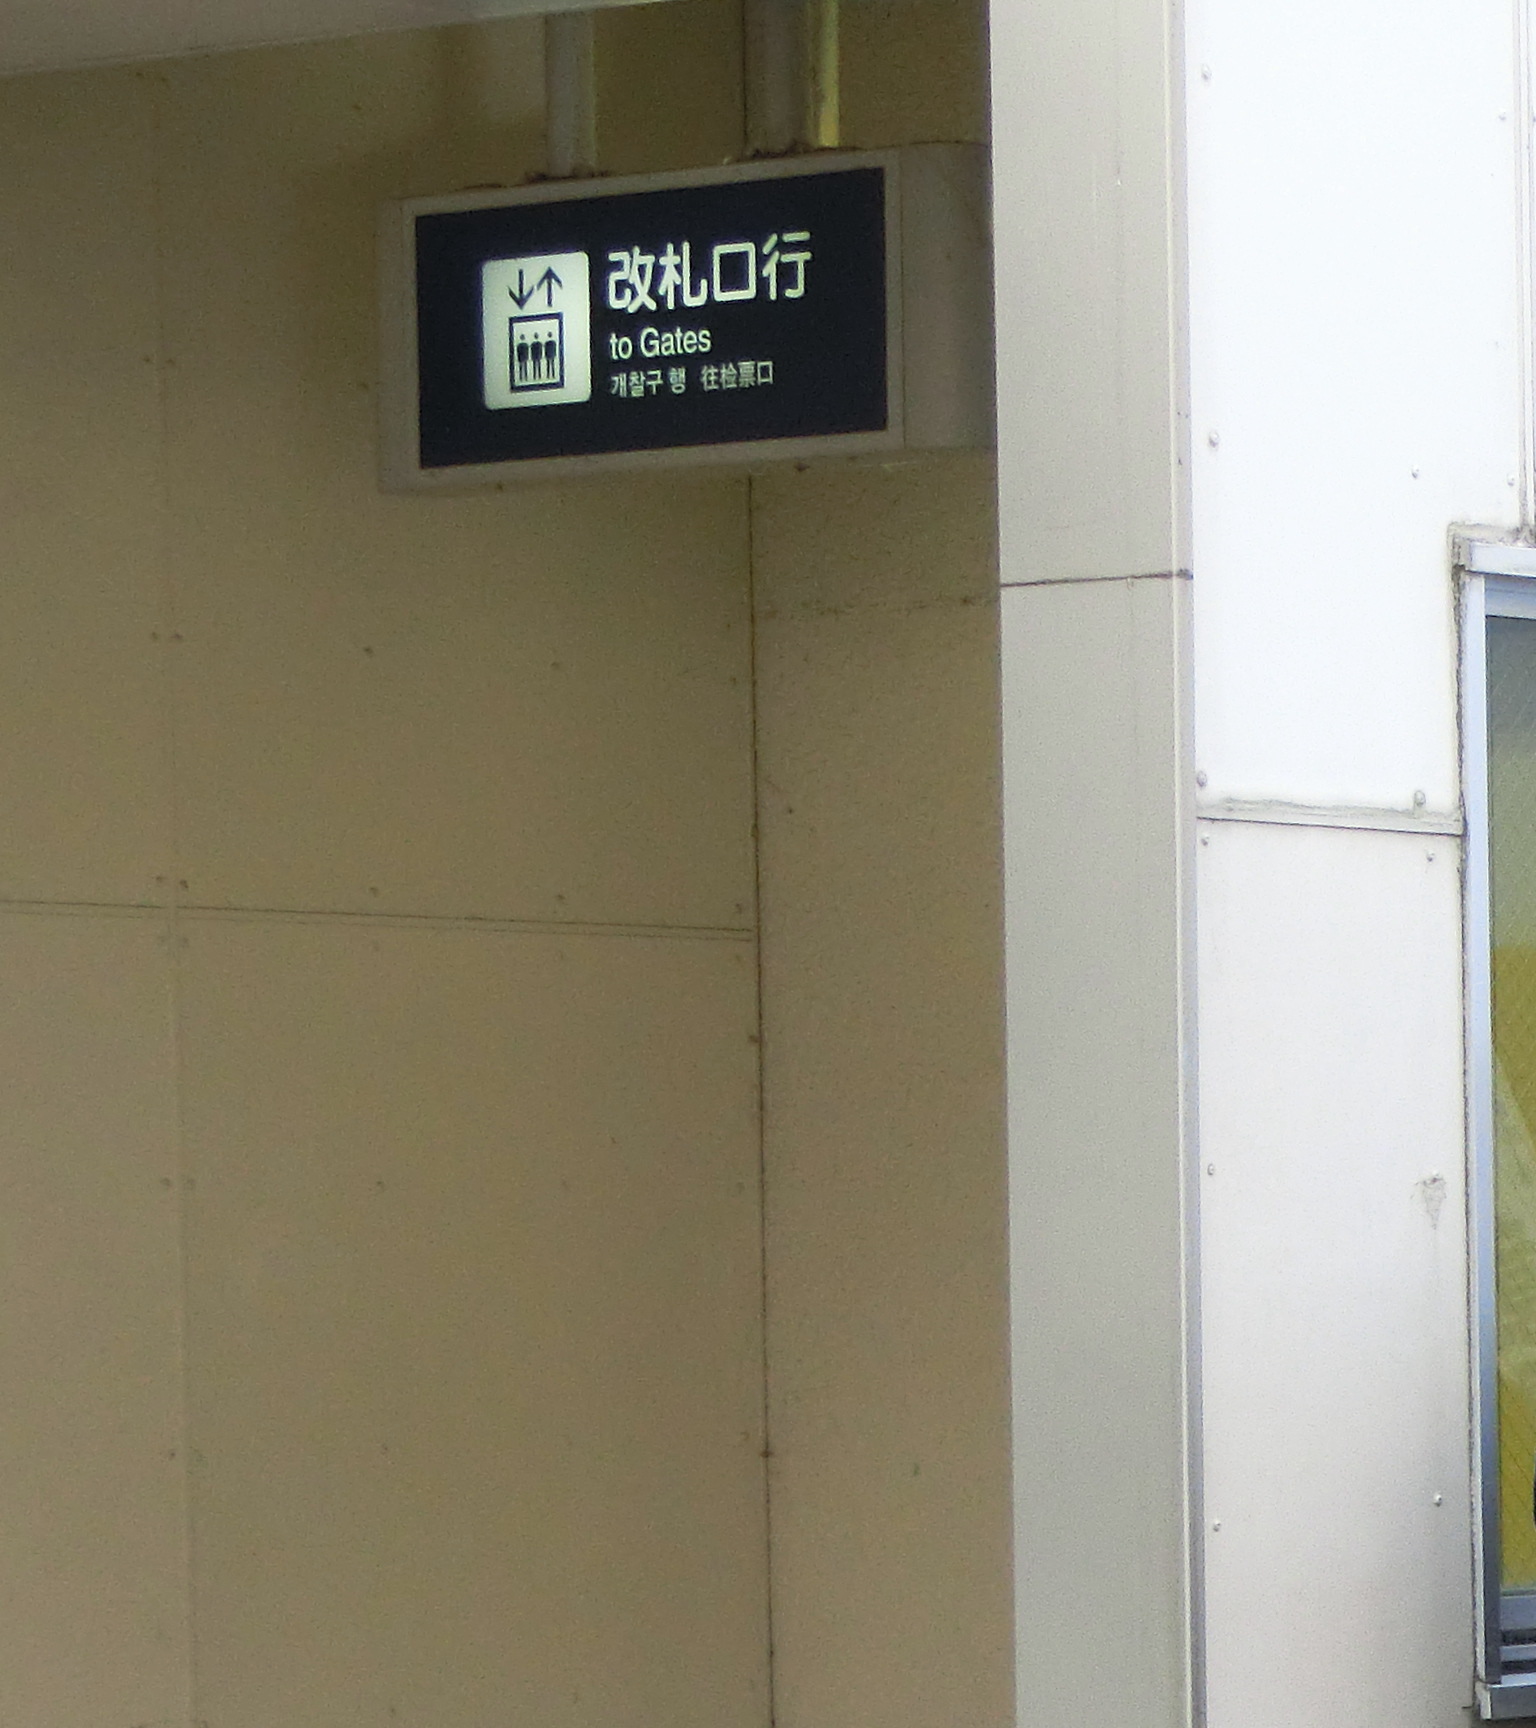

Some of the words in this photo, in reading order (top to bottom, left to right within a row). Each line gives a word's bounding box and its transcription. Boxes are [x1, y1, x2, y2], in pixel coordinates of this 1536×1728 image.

[606, 231, 812, 314] 改札口行
[609, 332, 633, 361] to
[640, 326, 712, 358] Gates
[610, 369, 664, 398] 개찰구
[668, 366, 687, 395] 행
[700, 360, 774, 392] 往检票口
